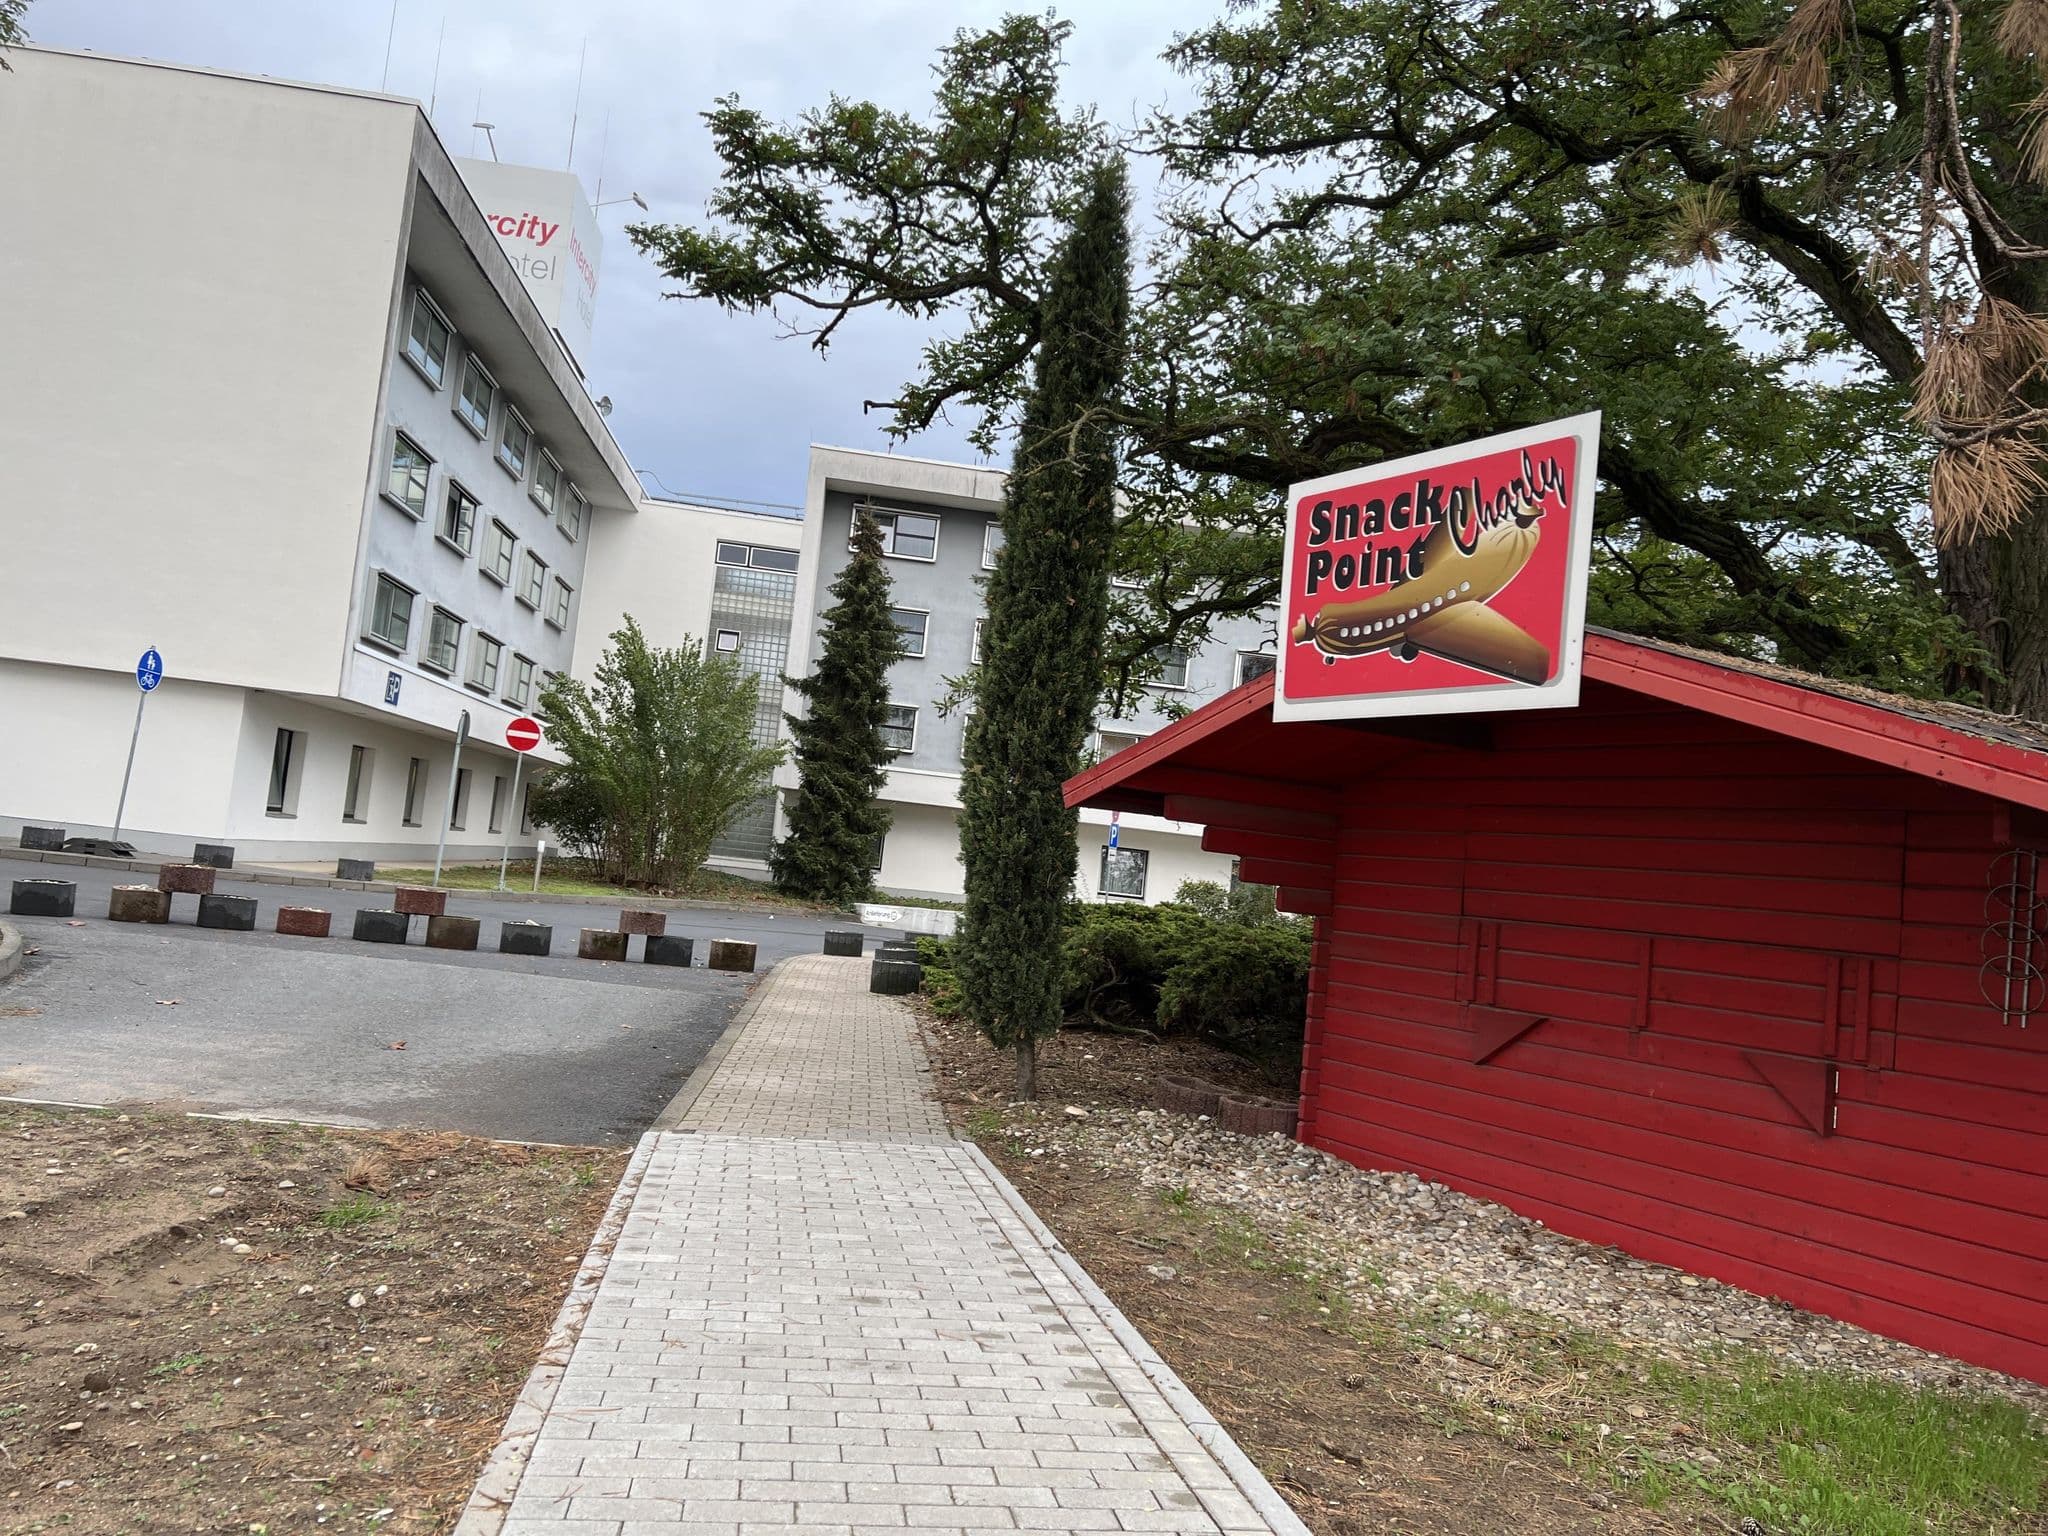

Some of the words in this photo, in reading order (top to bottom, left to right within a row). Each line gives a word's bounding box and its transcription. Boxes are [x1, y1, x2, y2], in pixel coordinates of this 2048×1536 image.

[1307, 478, 1444, 547] Snack
[1447, 449, 1567, 557] Charly
[1305, 537, 1426, 596] Point
[391, 676, 400, 702] P
[1111, 825, 1118, 844] P
